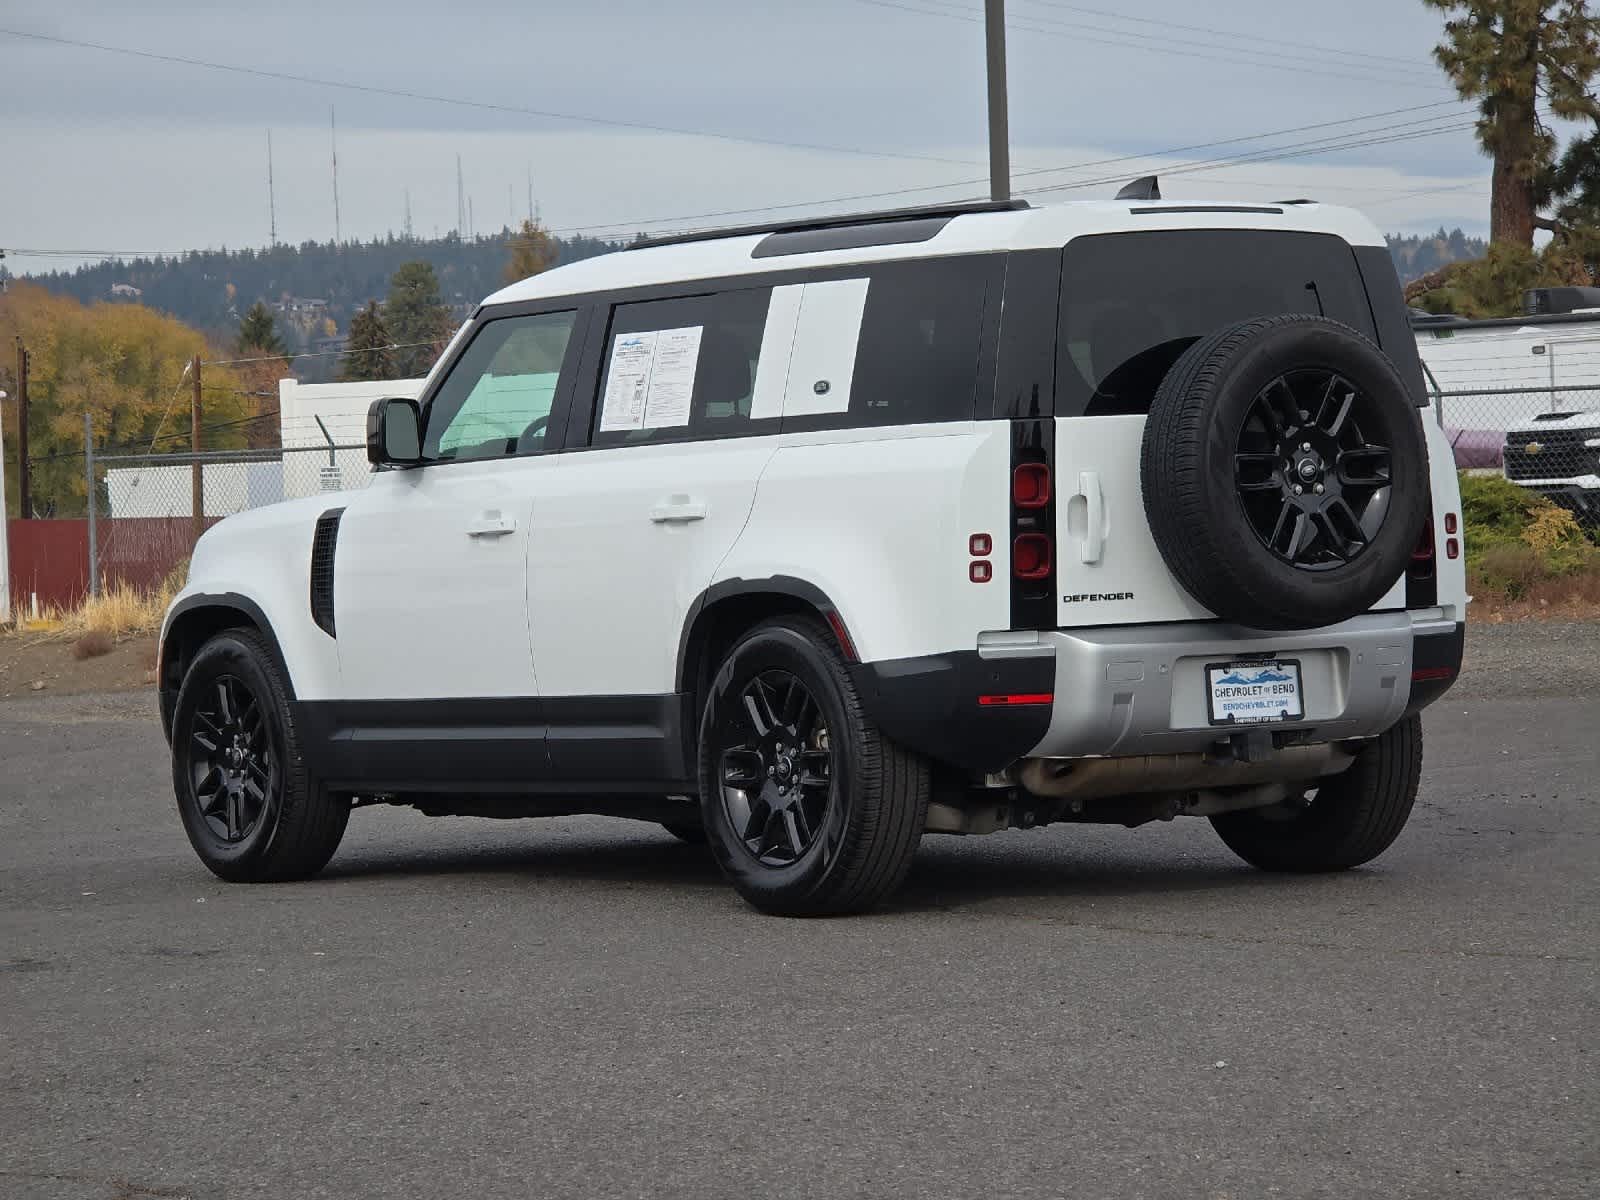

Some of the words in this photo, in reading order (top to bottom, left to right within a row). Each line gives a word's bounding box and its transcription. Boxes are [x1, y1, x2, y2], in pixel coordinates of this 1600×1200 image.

[1063, 592, 1134, 603] DEFENDER
[1215, 686, 1262, 698] CHEVROLET
[1272, 684, 1295, 695] BEND
